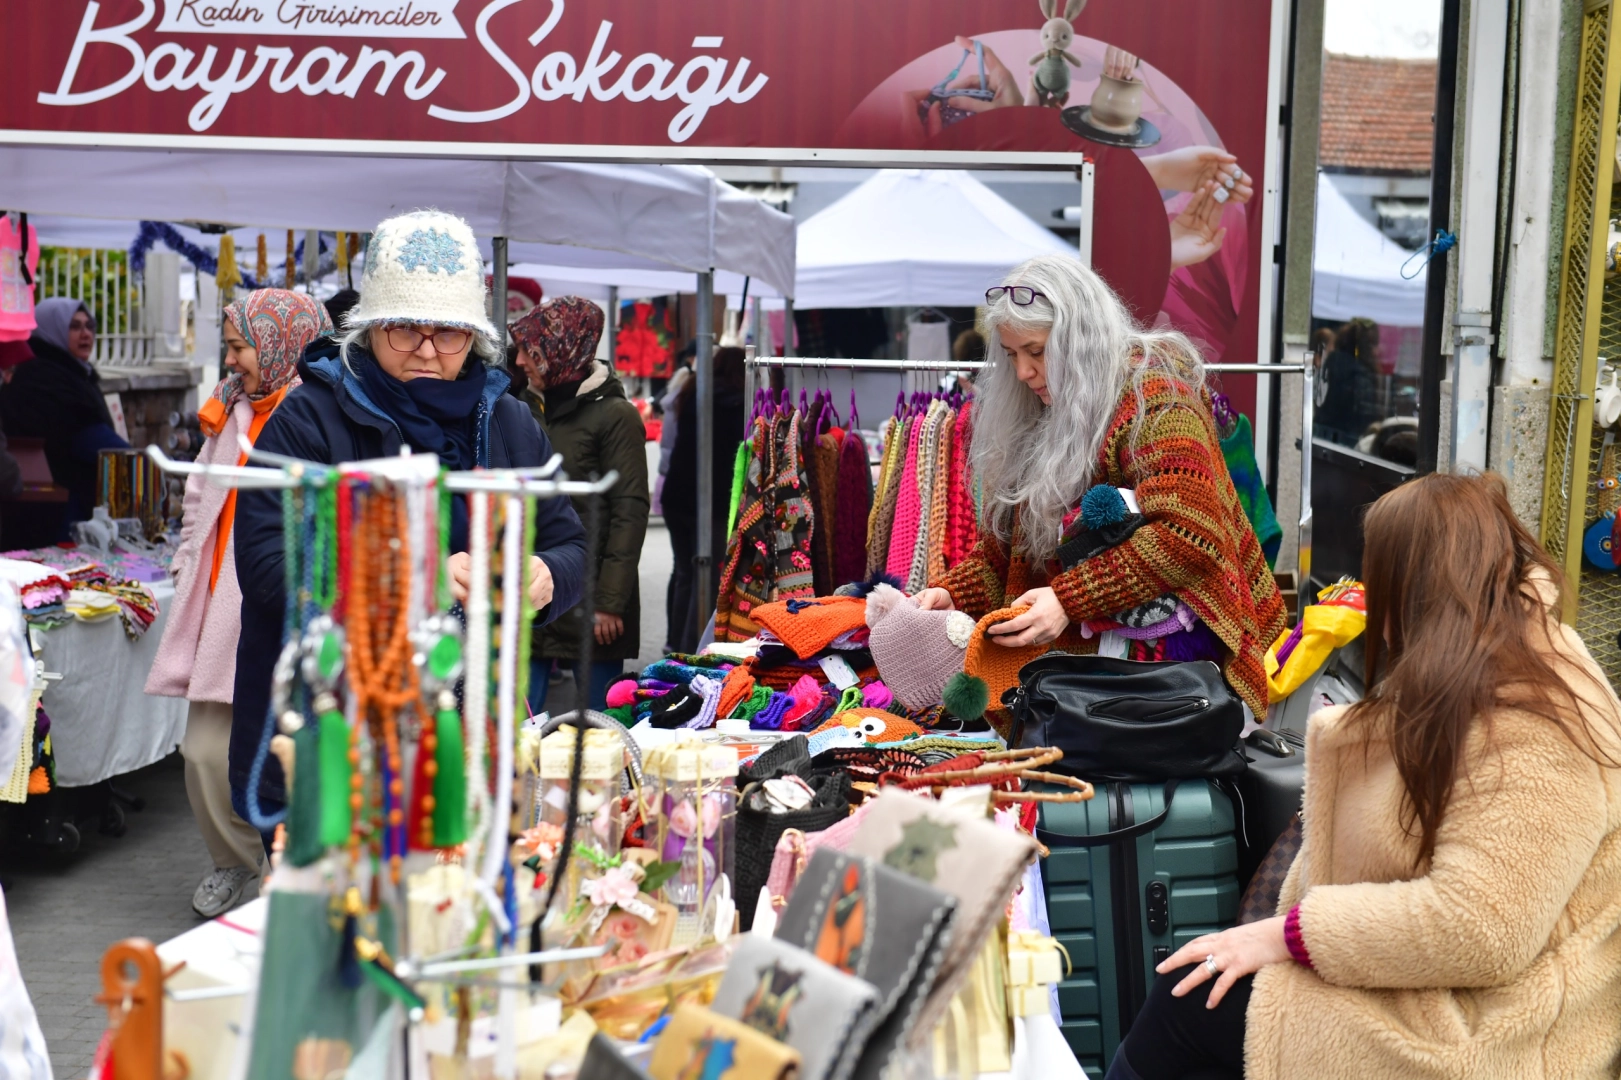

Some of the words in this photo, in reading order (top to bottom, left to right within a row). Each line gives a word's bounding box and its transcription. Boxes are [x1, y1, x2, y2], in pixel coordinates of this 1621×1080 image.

[176, 0, 263, 27] Kadın
[277, 0, 442, 29] Girişimciler
[37, 0, 447, 131] Bayram
[427, 0, 769, 143] Sokağı
